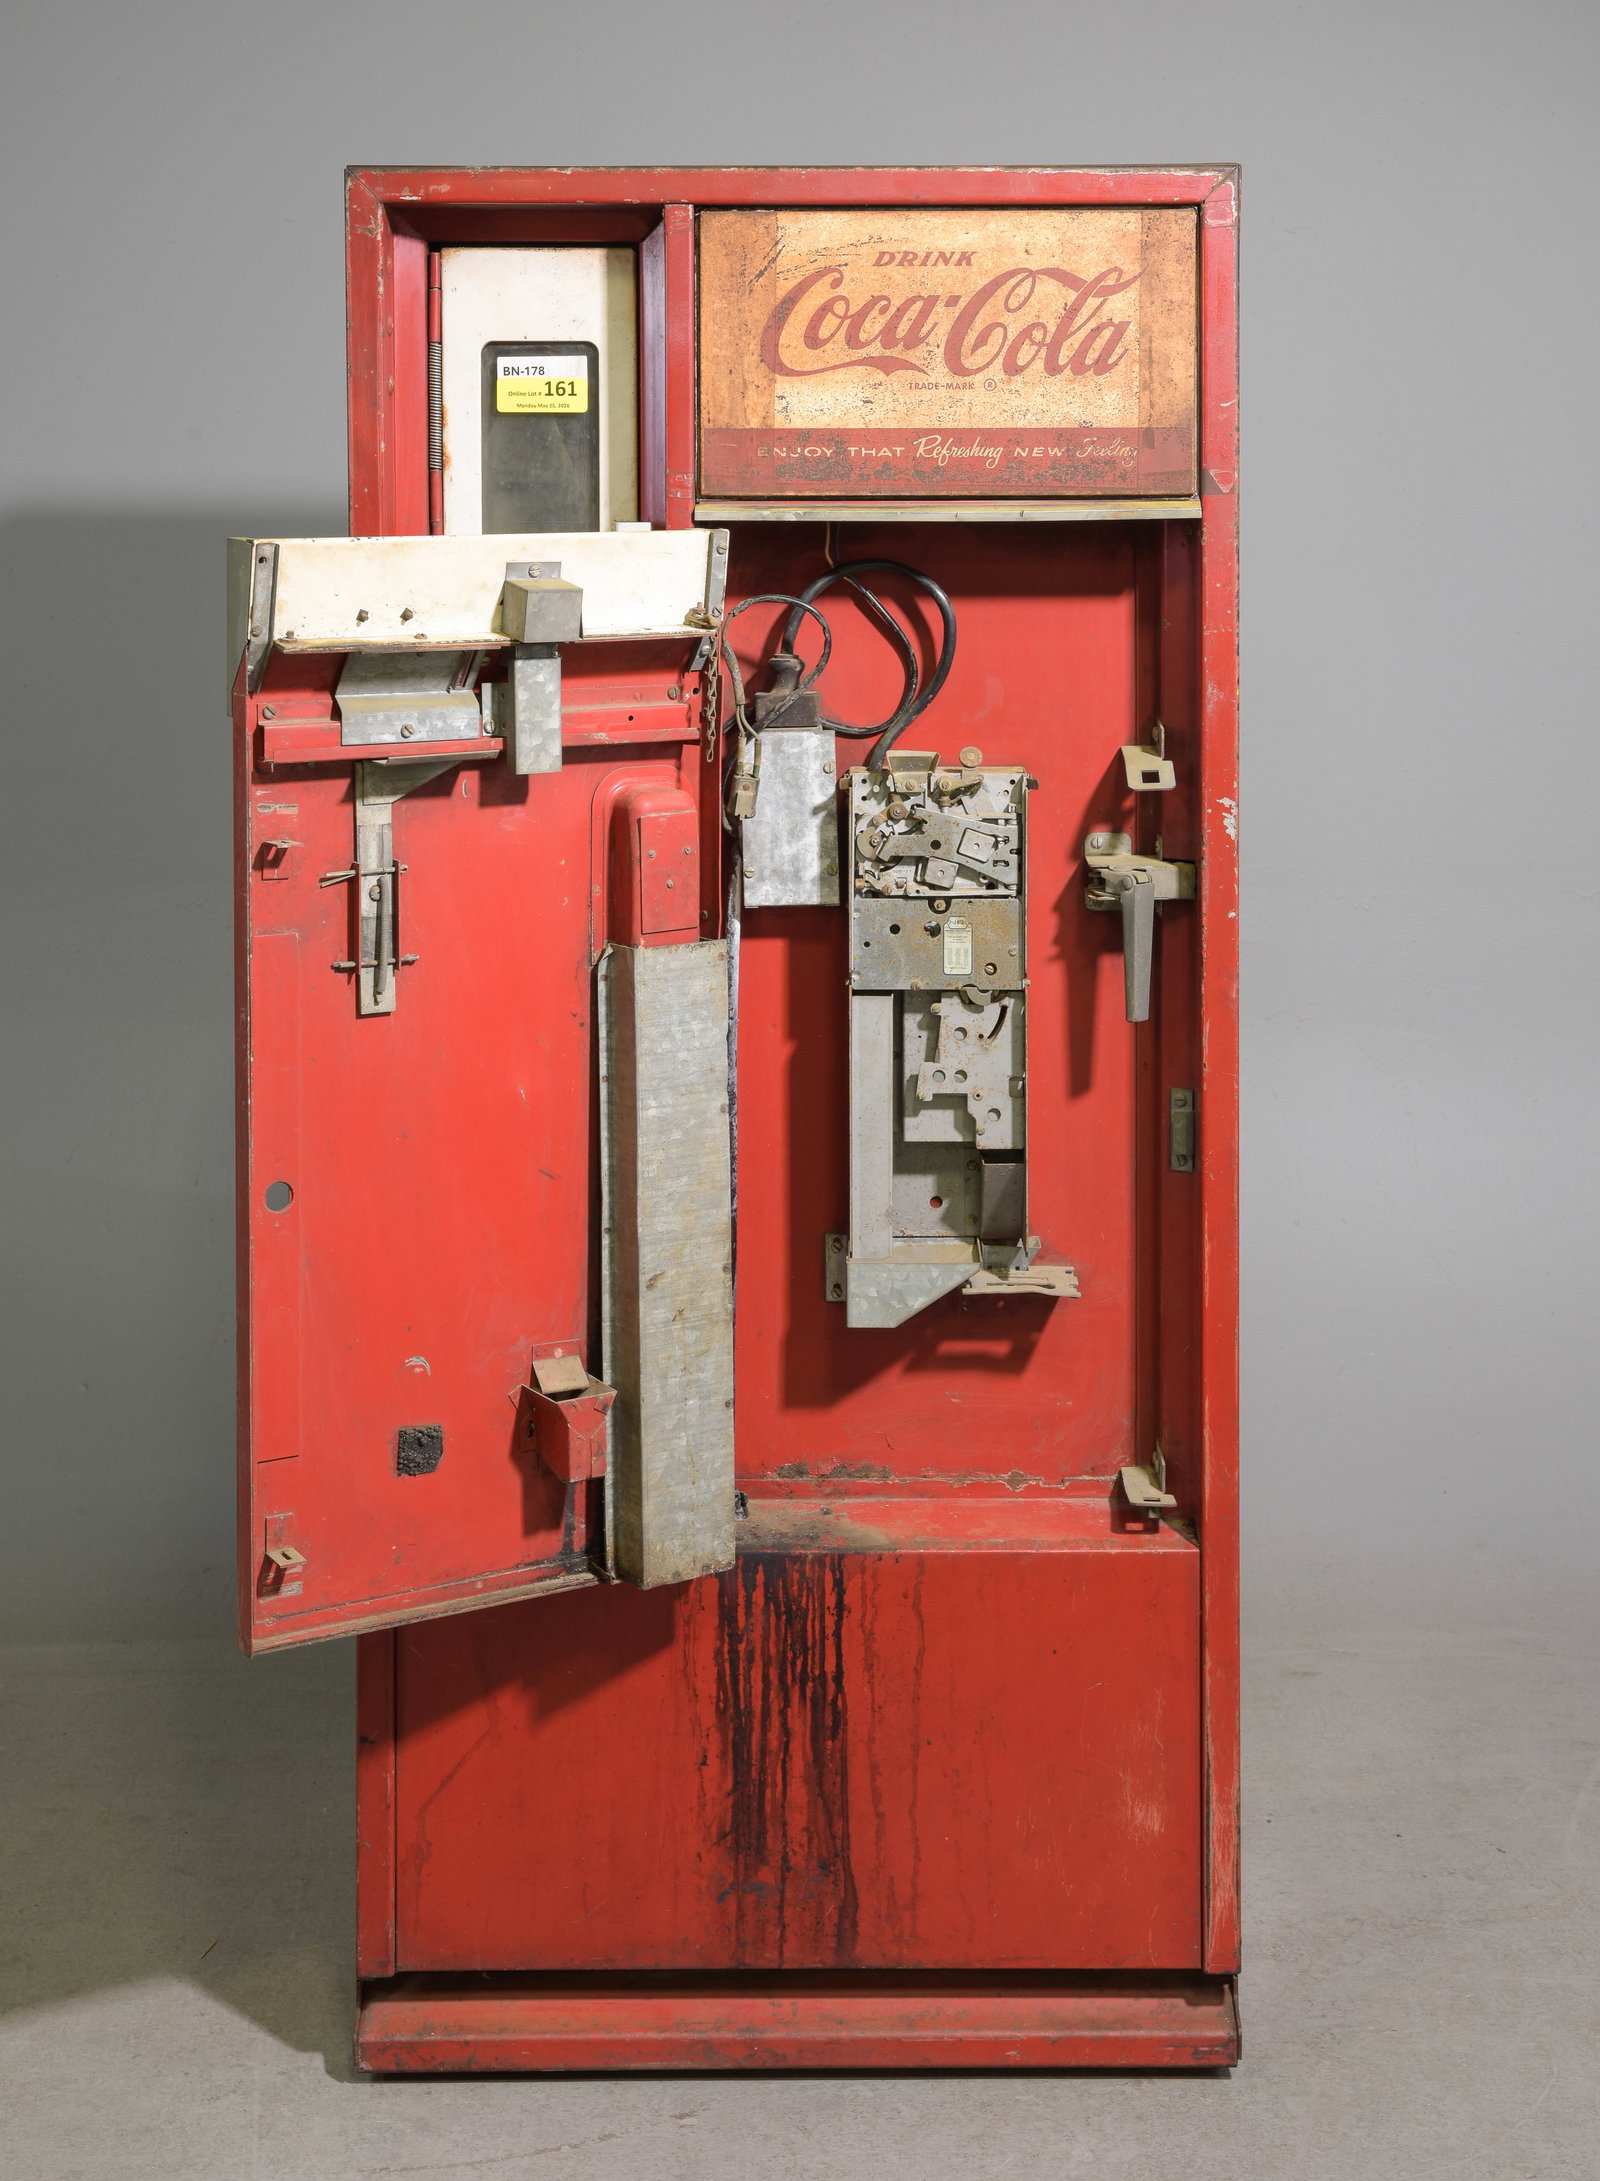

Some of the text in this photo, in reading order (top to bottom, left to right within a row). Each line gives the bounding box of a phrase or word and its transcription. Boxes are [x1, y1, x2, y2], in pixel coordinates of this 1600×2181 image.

[872, 251, 977, 267] DRINK
[759, 267, 1147, 377] Coca-Cola
[503, 366, 545, 376] BN-178
[544, 381, 577, 397] 161
[908, 382, 975, 390] TRADE-MARK
[757, 446, 837, 458] ENJOY
[848, 446, 905, 458] THAT
[915, 435, 1004, 468] Refreshing
[1013, 447, 1066, 458] NEW
